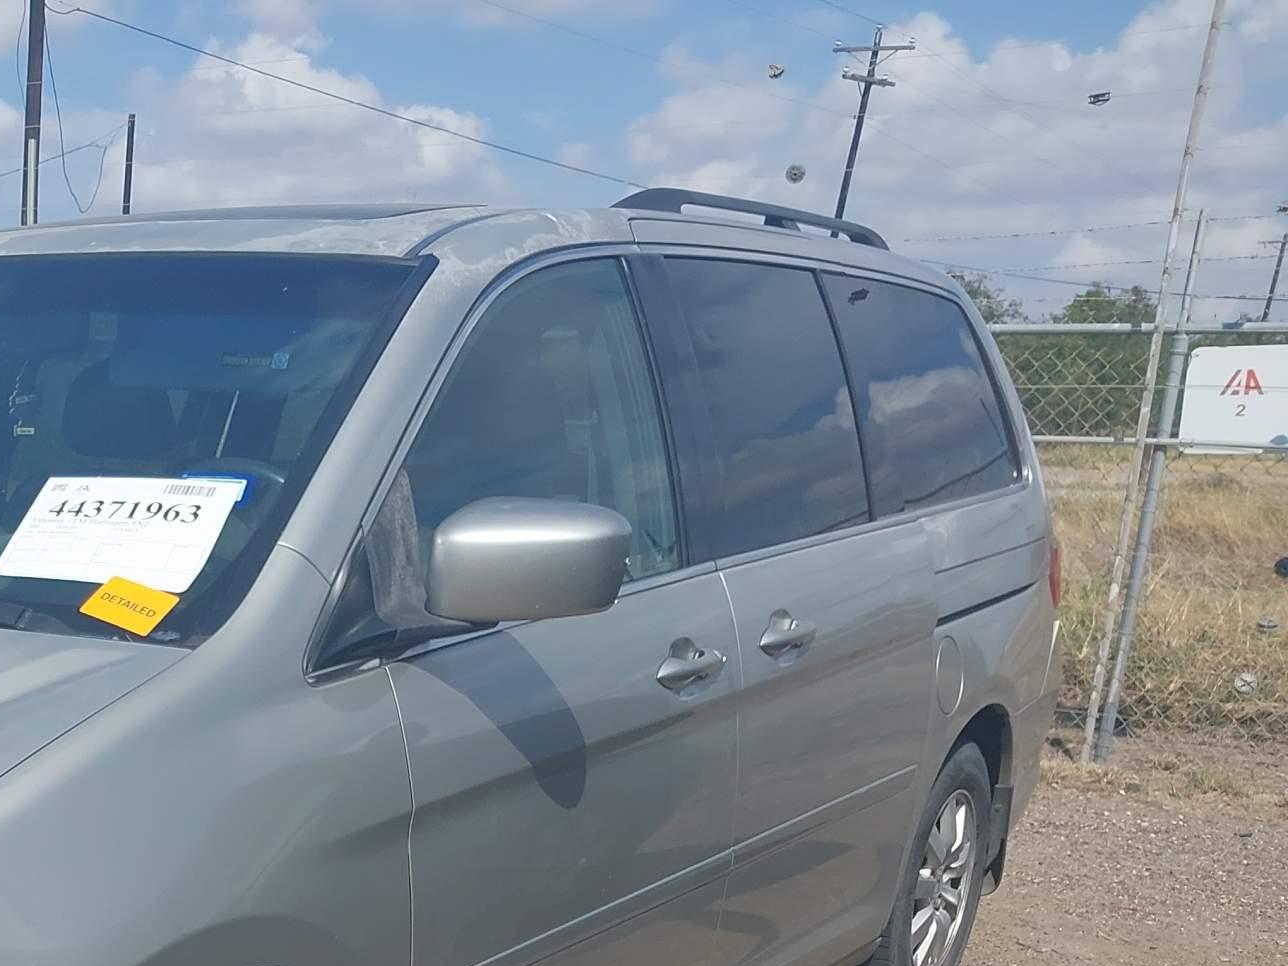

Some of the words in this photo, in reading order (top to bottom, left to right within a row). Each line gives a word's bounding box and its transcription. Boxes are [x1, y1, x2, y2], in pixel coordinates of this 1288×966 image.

[1235, 403, 1247, 417] 2
[48, 499, 202, 524] 44371963
[100, 592, 157, 618] DETAILED
